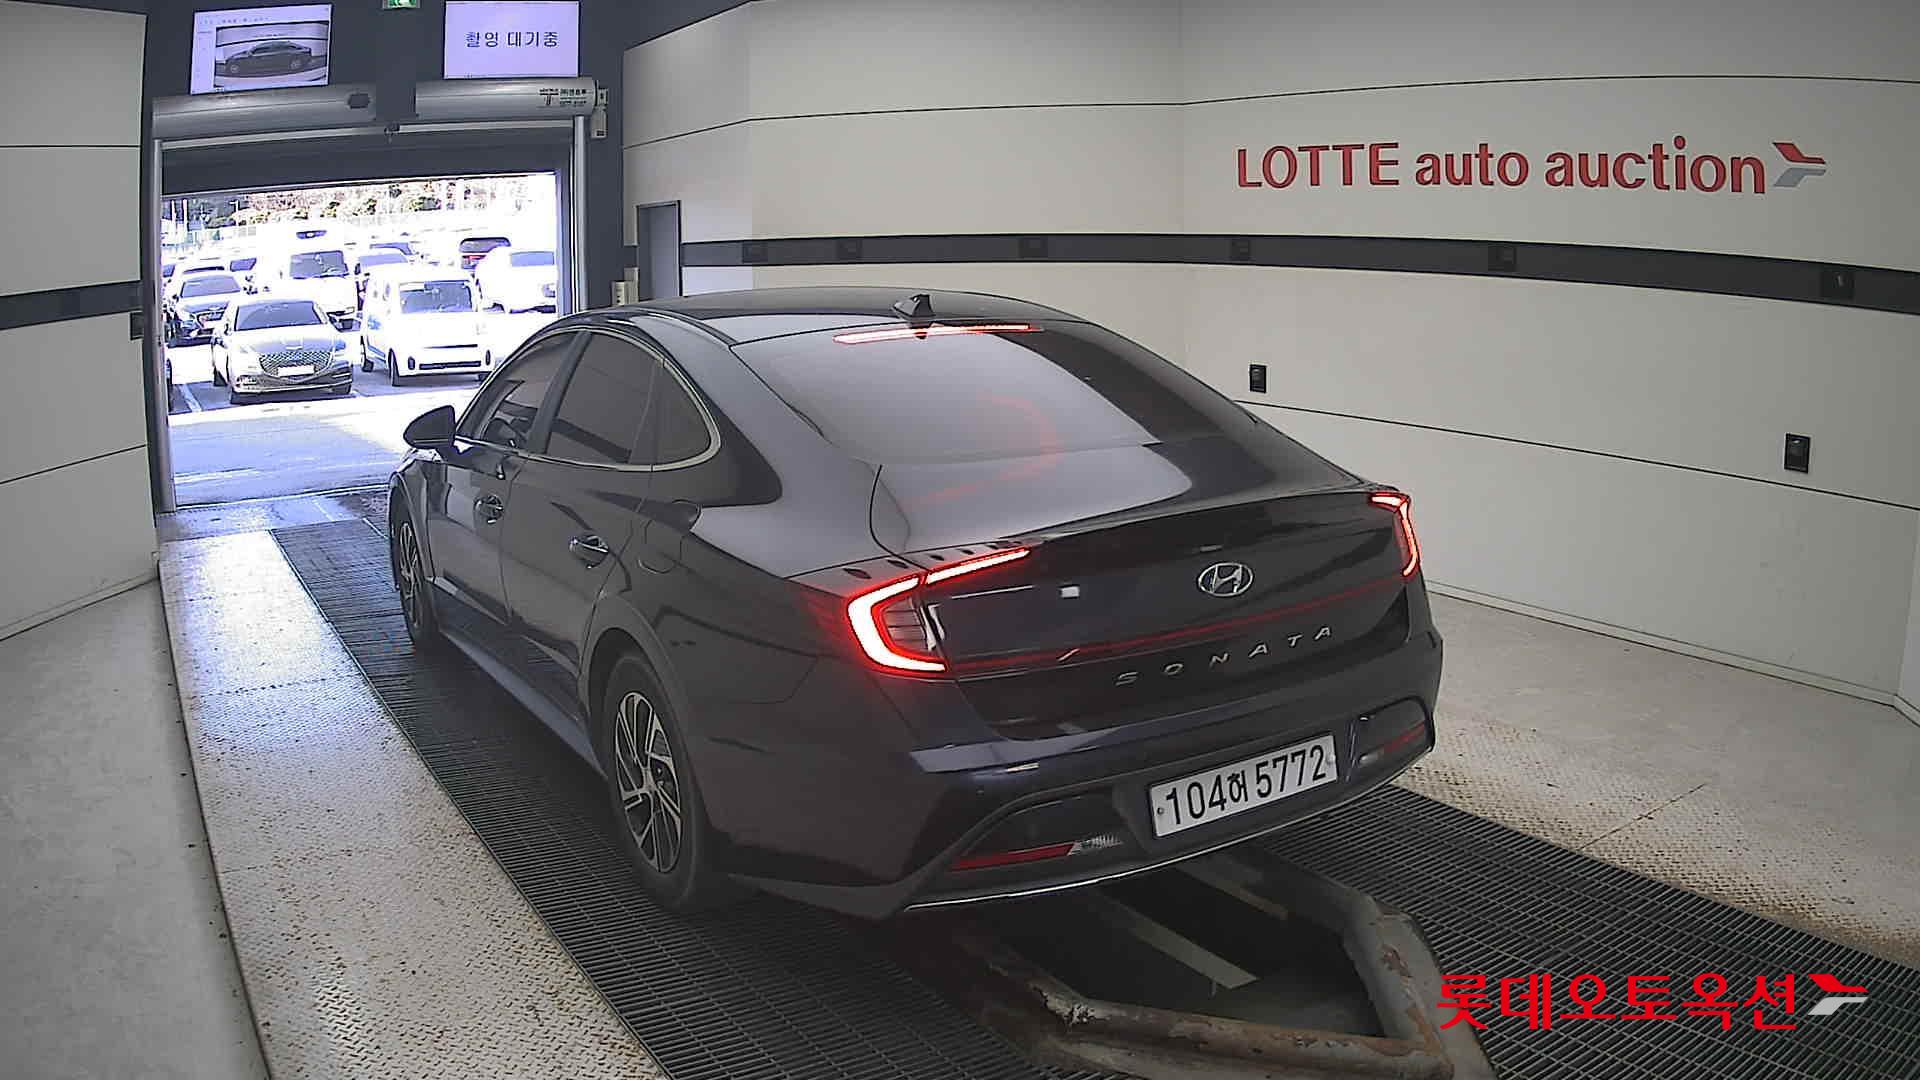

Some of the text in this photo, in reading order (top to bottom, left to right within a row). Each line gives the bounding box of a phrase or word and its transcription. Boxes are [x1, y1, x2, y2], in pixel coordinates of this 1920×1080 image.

[507, 31, 559, 48] 대기중
[1237, 136, 1766, 194] LOTTE auto auction
[1115, 625, 1333, 686] SONATA
